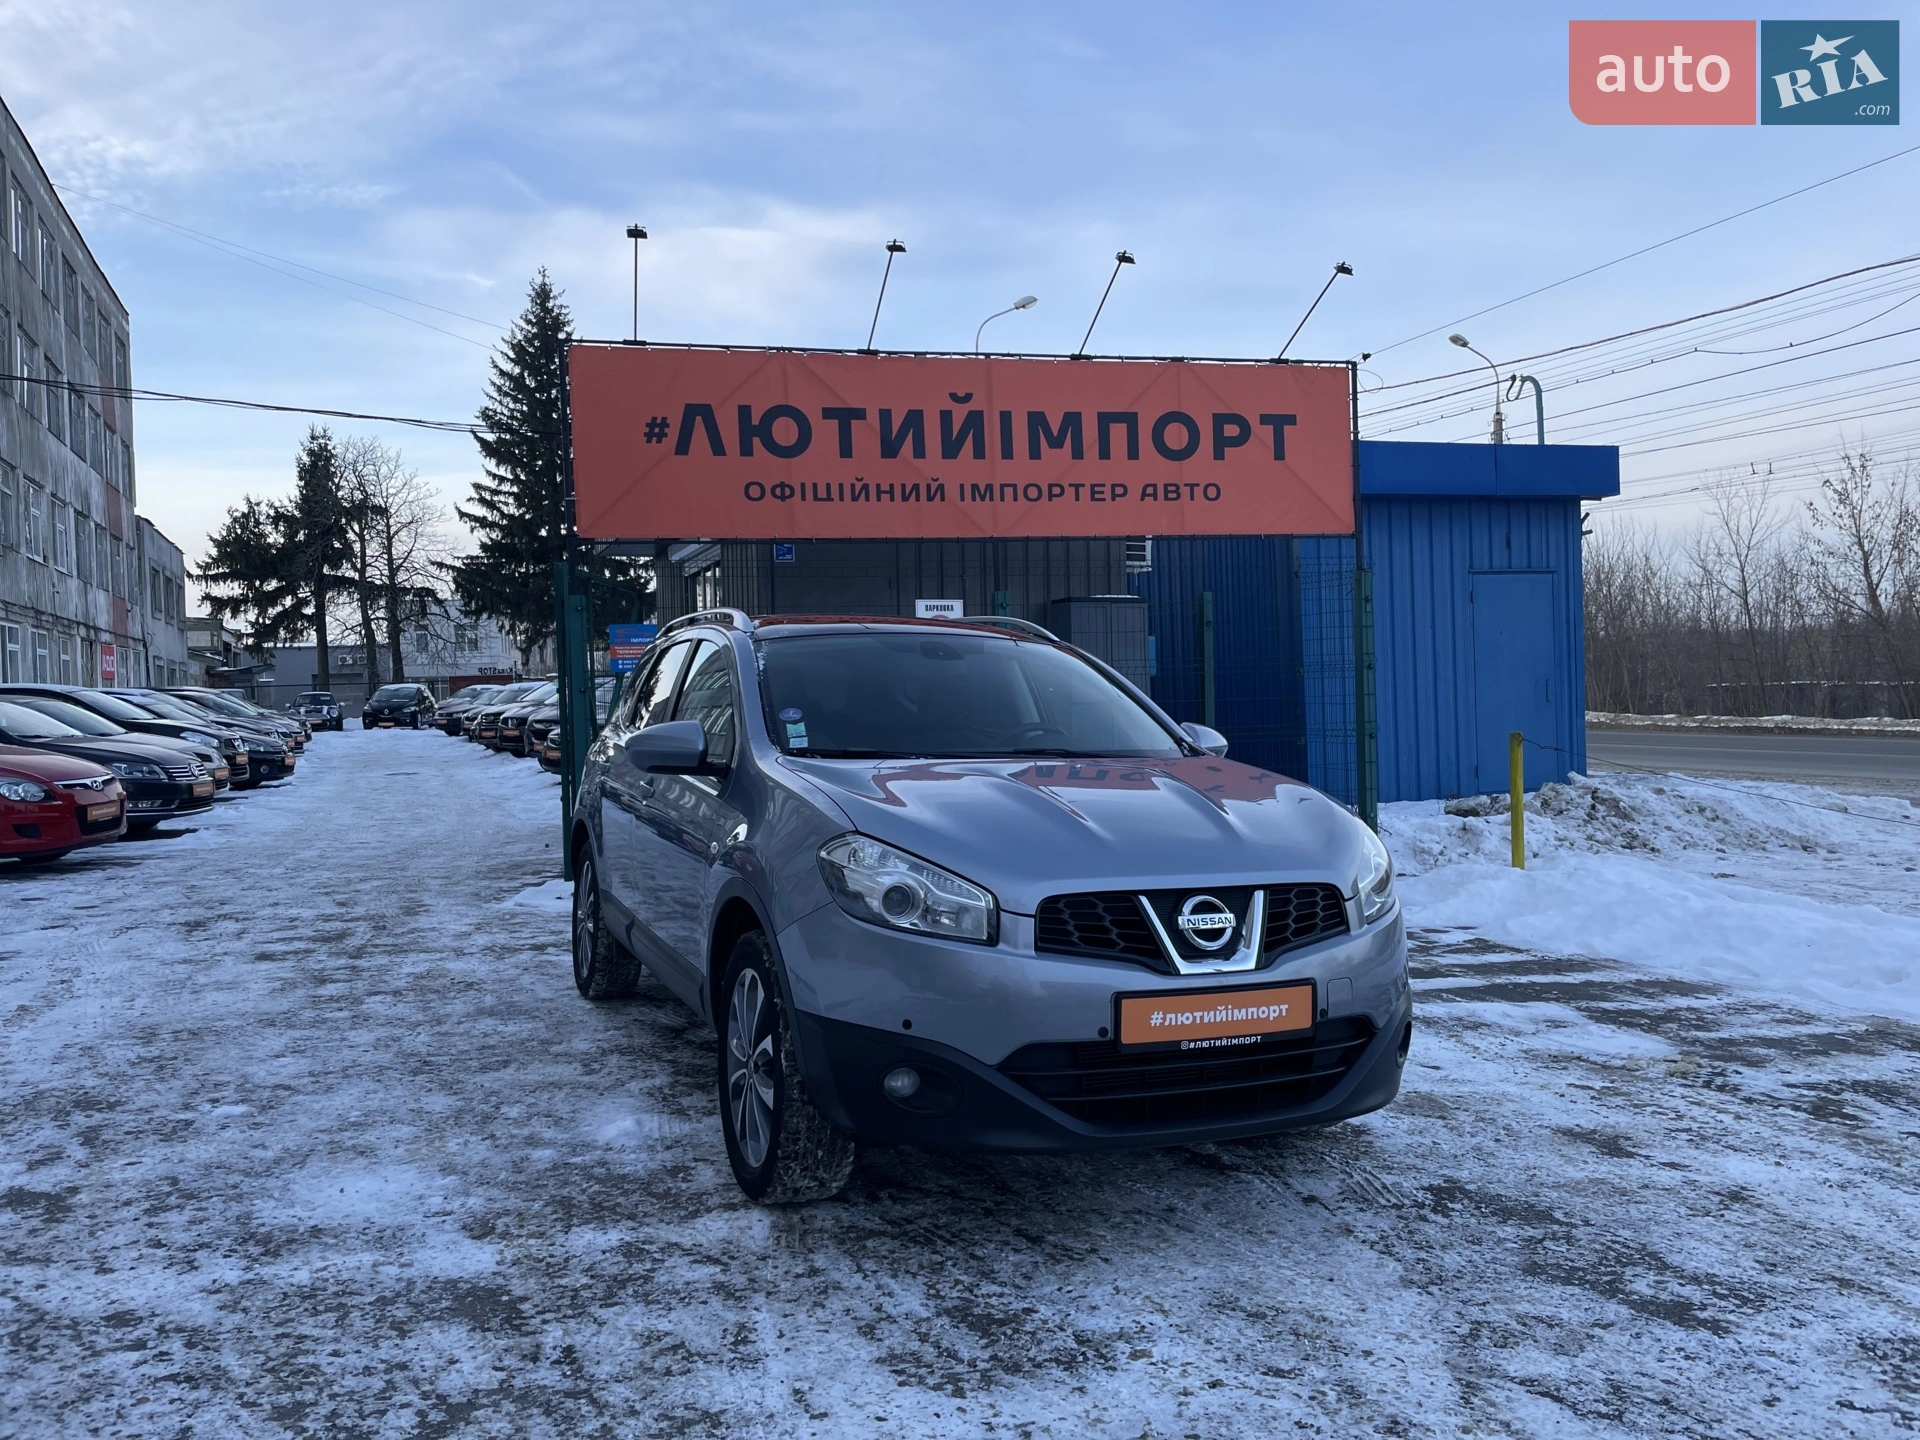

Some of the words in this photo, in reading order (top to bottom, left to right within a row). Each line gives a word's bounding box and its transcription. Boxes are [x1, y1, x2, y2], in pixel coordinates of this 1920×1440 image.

[643, 392, 1298, 462] #ЛЮТИЙІМПОРТ
[744, 476, 947, 503] ОФІЦІЙНИЙ
[959, 482, 1129, 503] ІМПОРТЕР
[1139, 482, 1222, 502] АВТО
[1186, 915, 1233, 927] NISSAN
[1149, 1004, 1289, 1027] #лютийімпорт
